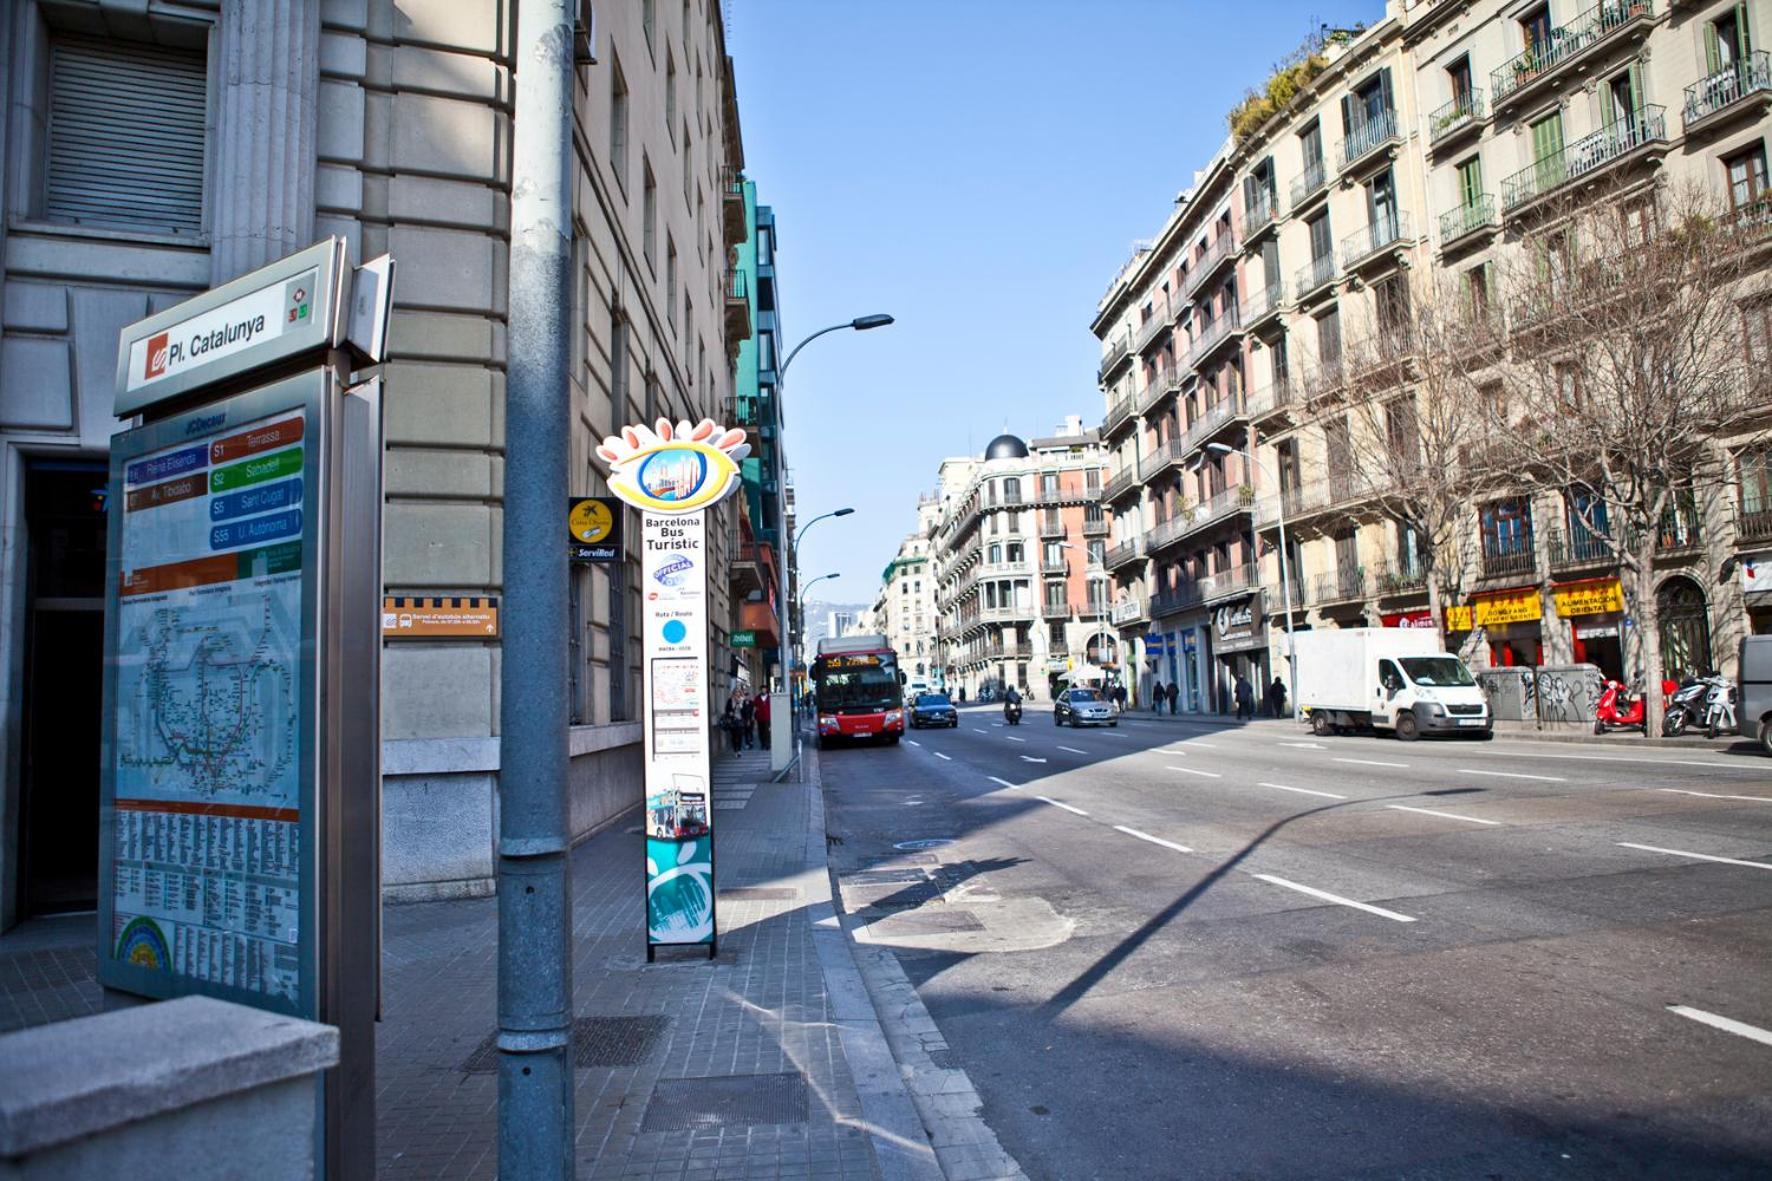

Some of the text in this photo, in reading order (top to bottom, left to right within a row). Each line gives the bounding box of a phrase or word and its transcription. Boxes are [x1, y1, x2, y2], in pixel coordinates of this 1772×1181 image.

[169, 314, 265, 366] Pl. Catalunya
[214, 430, 280, 458] S1 Terrassa
[213, 472, 225, 486] S2
[213, 500, 225, 515] S5
[645, 518, 700, 527] Barcelona
[661, 527, 684, 537] Bus
